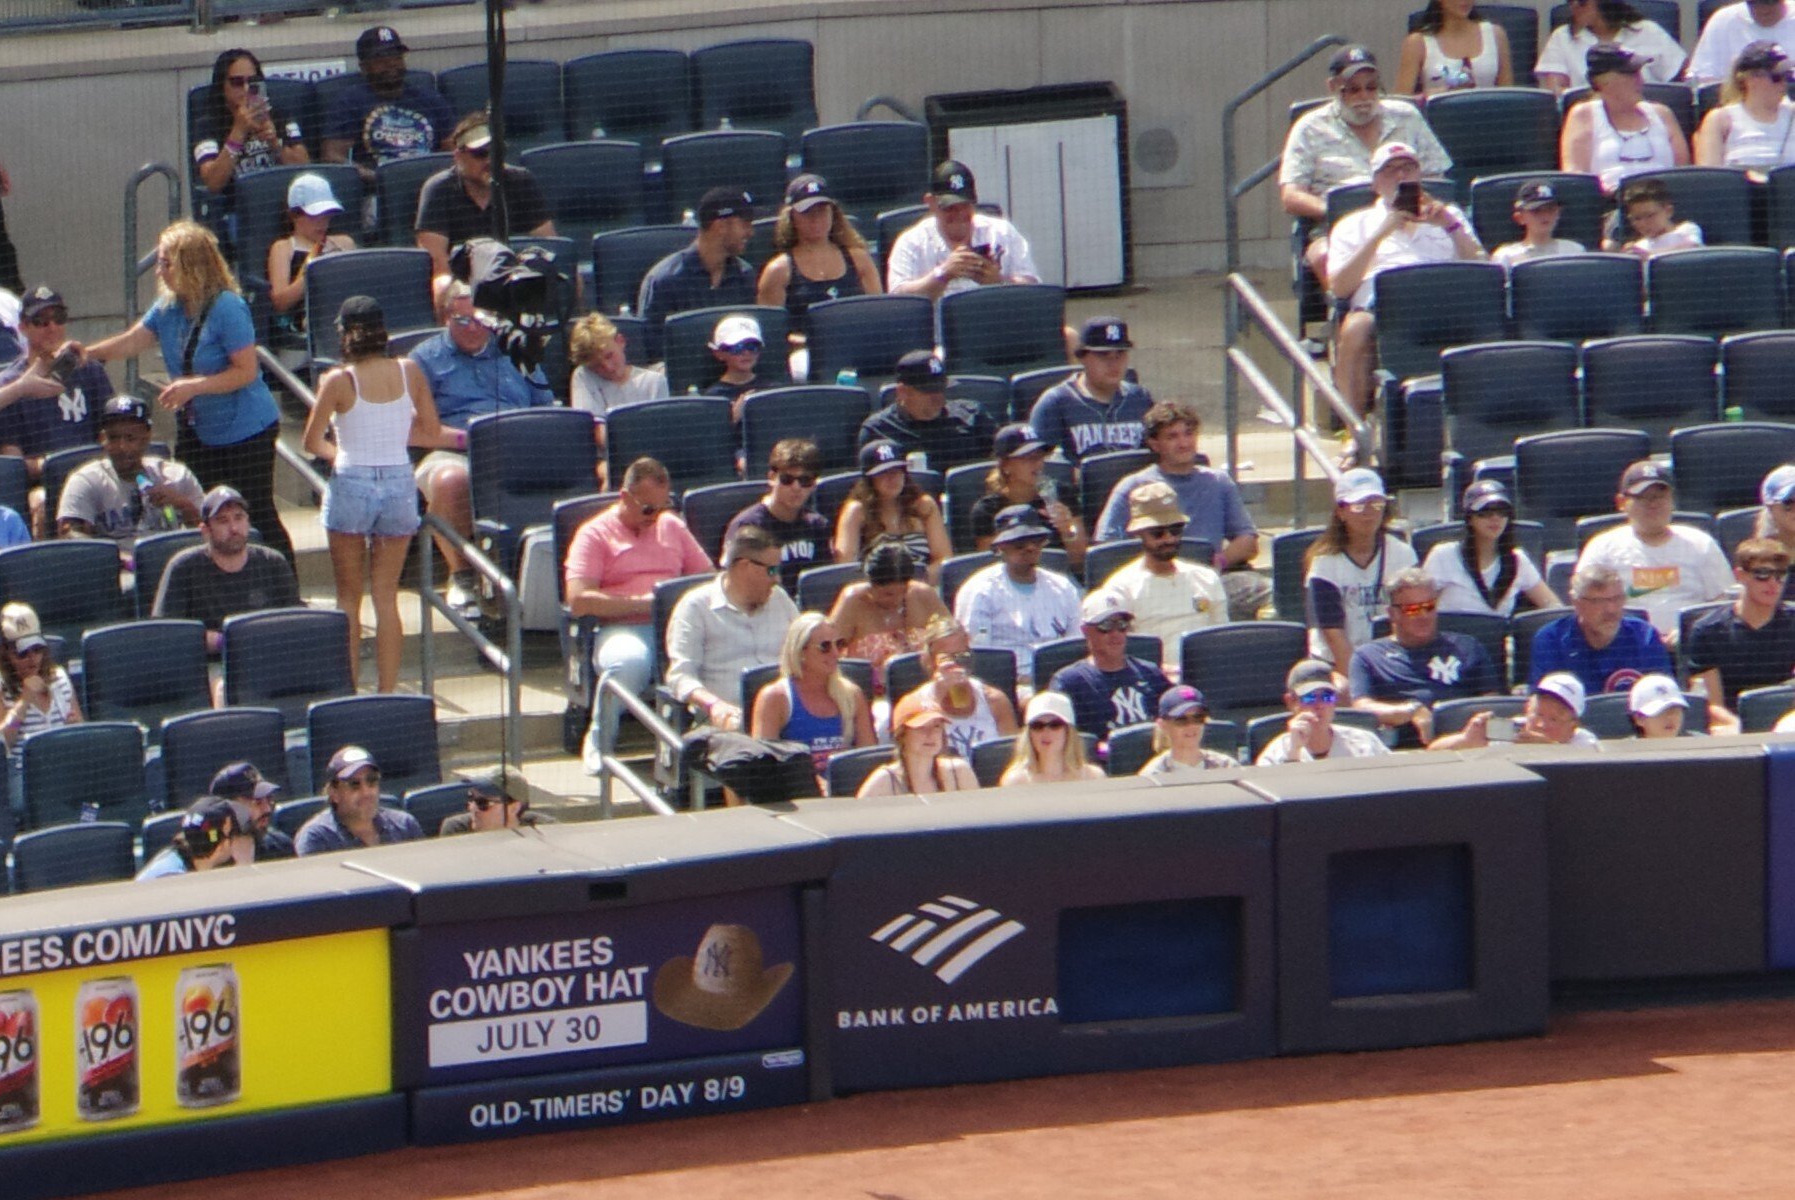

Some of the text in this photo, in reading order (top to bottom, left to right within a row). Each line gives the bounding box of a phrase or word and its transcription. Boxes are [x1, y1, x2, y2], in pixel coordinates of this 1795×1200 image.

[58, 388, 87, 422] NY
[1427, 655, 1461, 685] NY
[1109, 686, 1148, 729] NY
[463, 937, 614, 980] YANKEES
[429, 966, 649, 1019] COWBOY HAT
[837, 998, 1059, 1028] BANK OF AMERICA
[477, 1015, 601, 1054] JULY 30
[641, 1081, 695, 1110] DAY
[704, 1076, 745, 1101] 8/9
